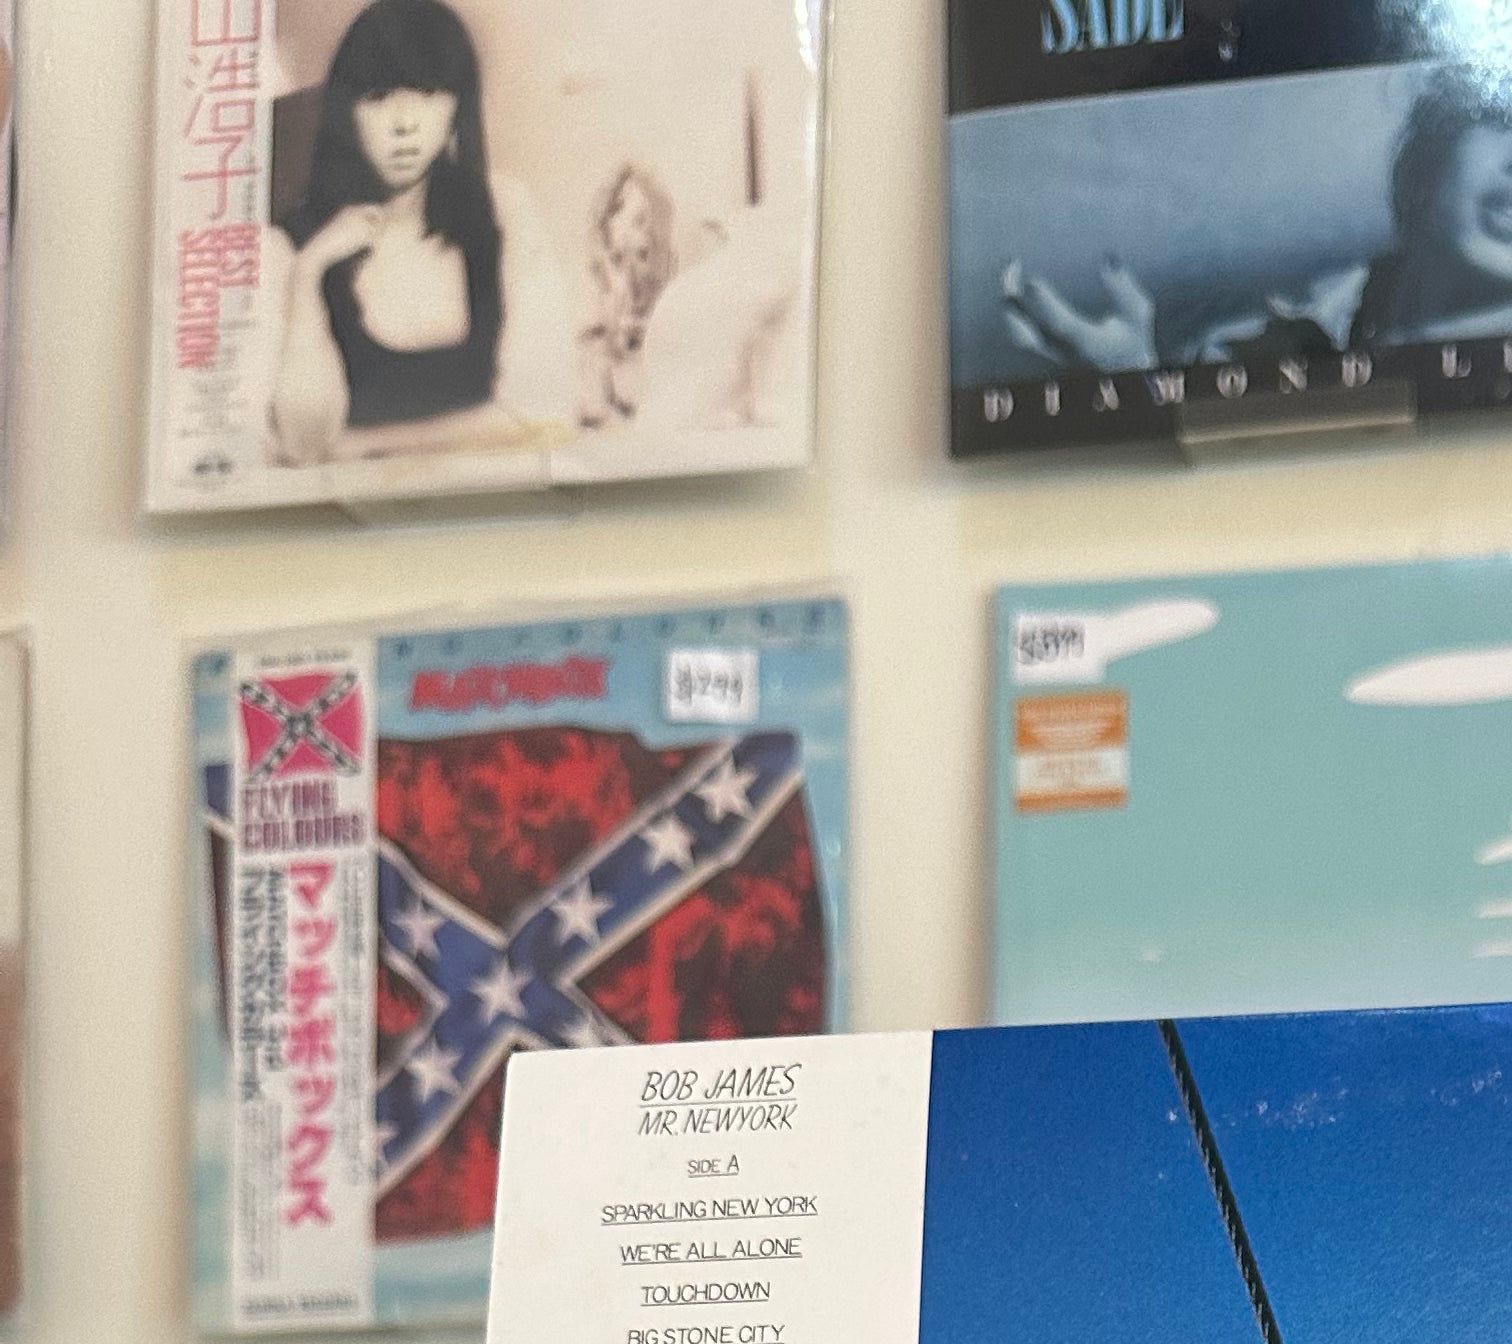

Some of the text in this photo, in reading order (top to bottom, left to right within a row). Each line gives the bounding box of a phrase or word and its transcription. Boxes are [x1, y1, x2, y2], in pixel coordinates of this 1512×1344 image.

[640, 1063, 803, 1102] BOB JAMES
[637, 1109, 679, 1137] MR.
[687, 1154, 741, 1175] SIDE A
[600, 1195, 819, 1224] SPARKLING NEW YORK
[620, 1237, 803, 1263] WE'RE ALL ALONE
[640, 1281, 771, 1305] TOUCHDOWN
[738, 1323, 786, 1344] CITY
